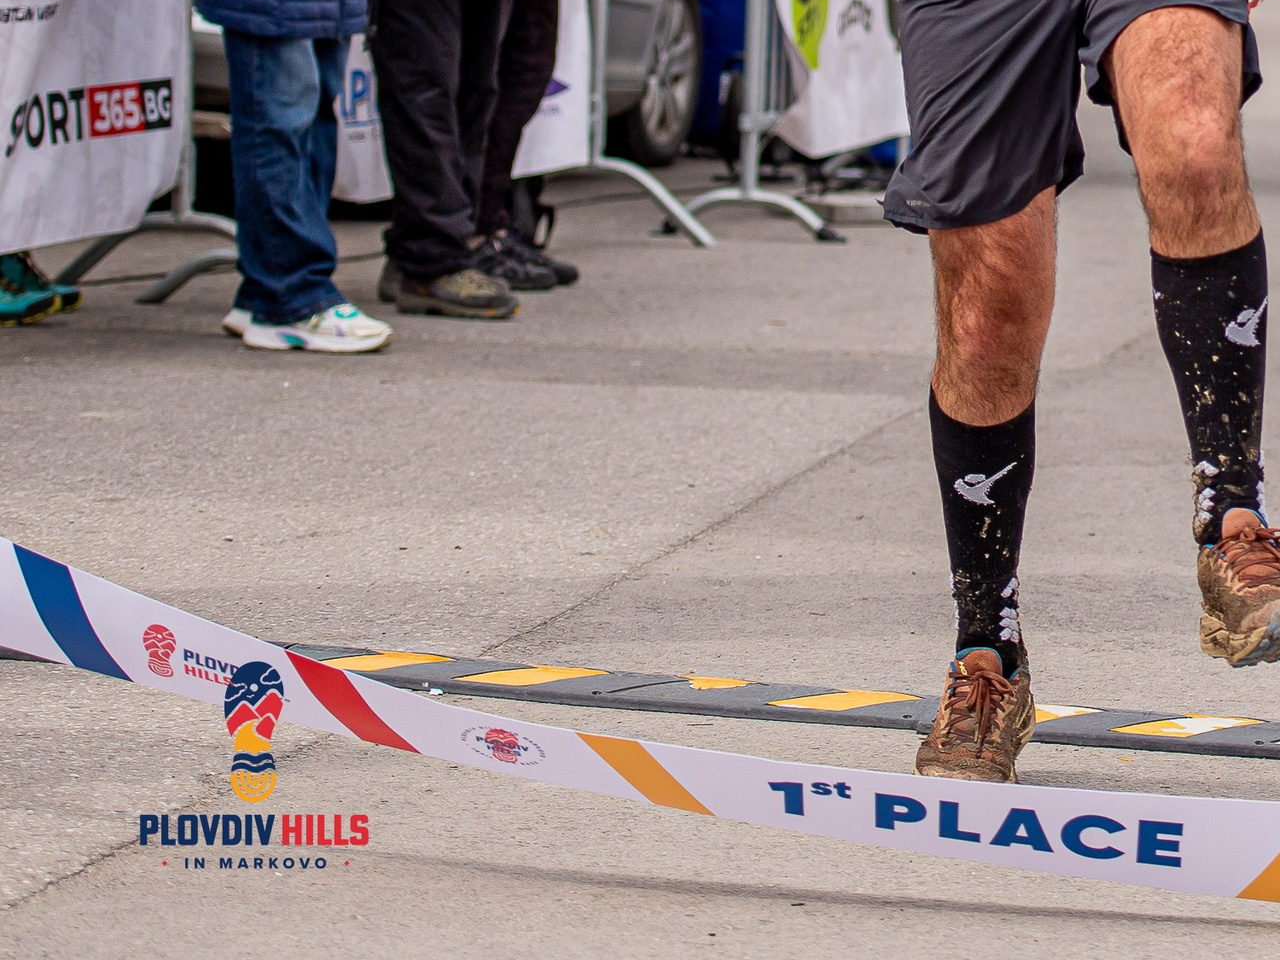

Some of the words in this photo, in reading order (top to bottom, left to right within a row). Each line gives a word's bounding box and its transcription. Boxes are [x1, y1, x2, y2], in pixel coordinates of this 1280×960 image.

[183, 648, 240, 676] PLOVD
[184, 664, 236, 687] HILLS
[768, 781, 852, 816] 1st
[874, 792, 1184, 868] PLACE
